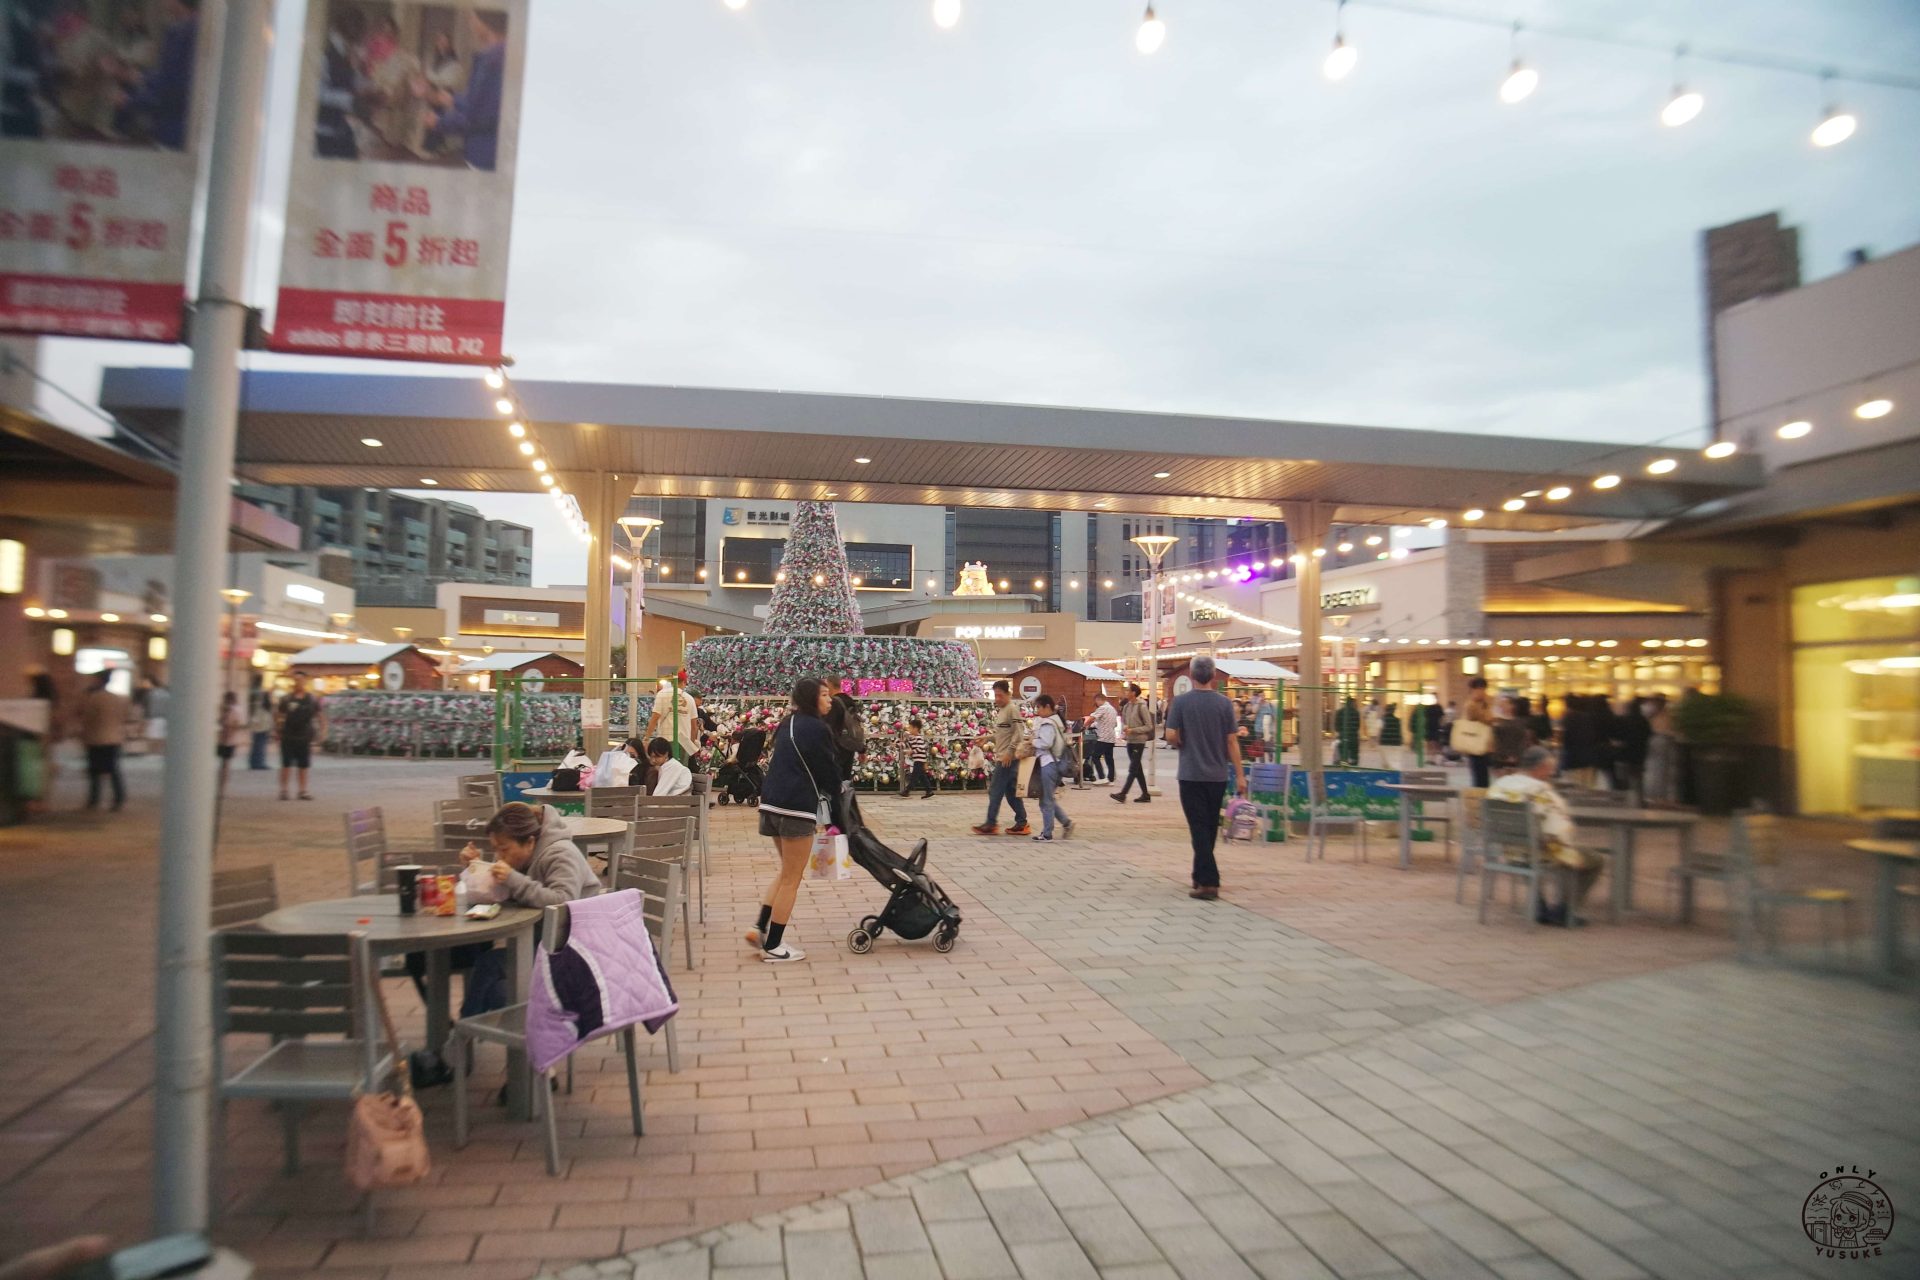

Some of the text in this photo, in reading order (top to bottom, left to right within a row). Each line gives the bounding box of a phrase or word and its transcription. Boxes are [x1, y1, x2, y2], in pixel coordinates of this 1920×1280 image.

[370, 183, 431, 216] 商品
[332, 298, 446, 331] 即刻前往
[955, 626, 1022, 639] POP MART
